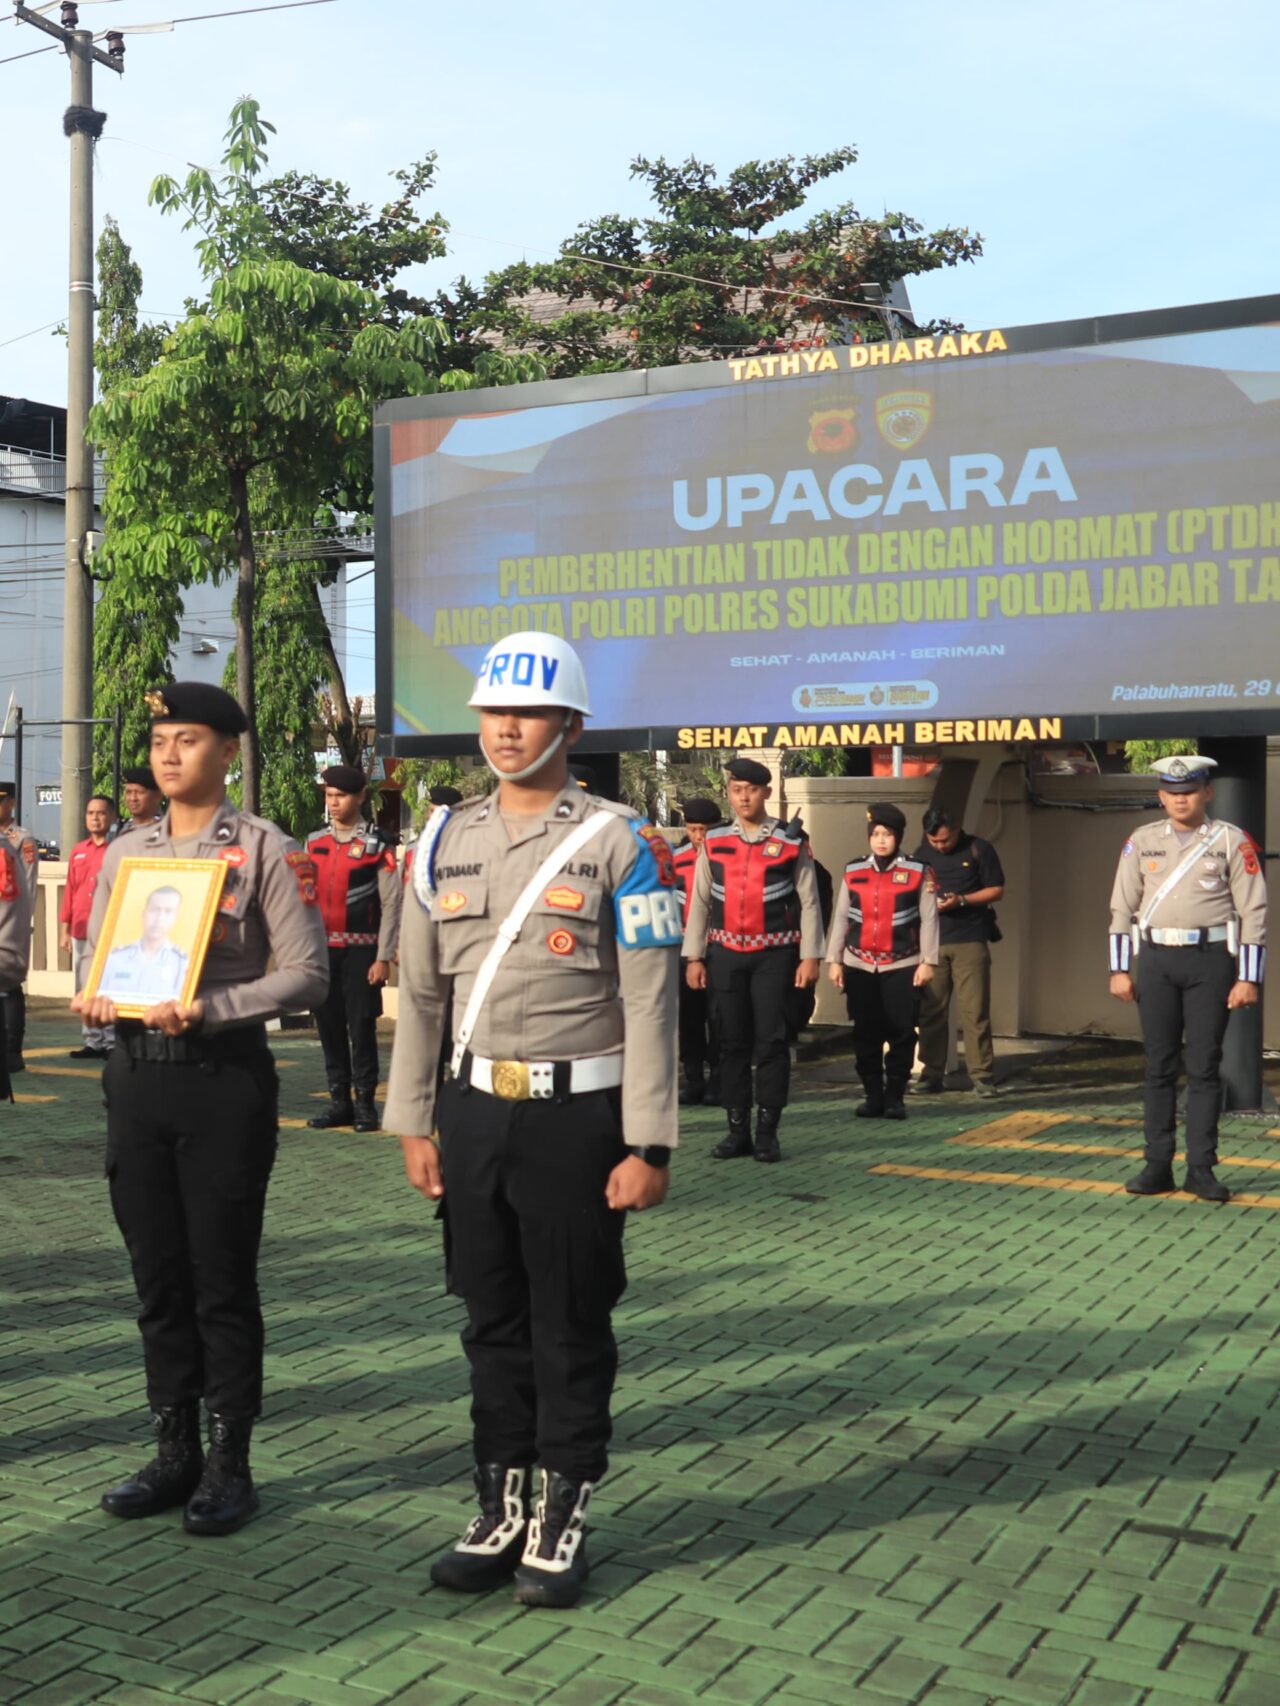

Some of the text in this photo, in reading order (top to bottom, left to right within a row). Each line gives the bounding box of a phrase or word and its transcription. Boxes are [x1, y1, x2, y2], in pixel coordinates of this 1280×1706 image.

[728, 329, 1008, 382] TATHYA DHARAKA
[672, 446, 1079, 532] UPACARA
[498, 542, 745, 598] PEMBERHENTIAN
[752, 535, 851, 581] TIDAK
[857, 524, 994, 576] DENGAN
[1002, 512, 1158, 565] HORMAT
[433, 602, 565, 647] ANGGOTA
[571, 597, 657, 640] POLRI
[663, 589, 779, 635] POLRES
[786, 577, 968, 630] SUKABUMI
[976, 569, 1093, 619] POLDA
[1098, 561, 1220, 612] JABAR
[729, 653, 794, 668] SEHAT
[806, 649, 897, 665] AMANAH
[910, 644, 1005, 659] BERIMAN
[1111, 682, 1238, 701] Palabuhanratu,
[1243, 679, 1272, 697] 29
[677, 717, 1062, 750] SEHAT AMANAH BERIMAN
